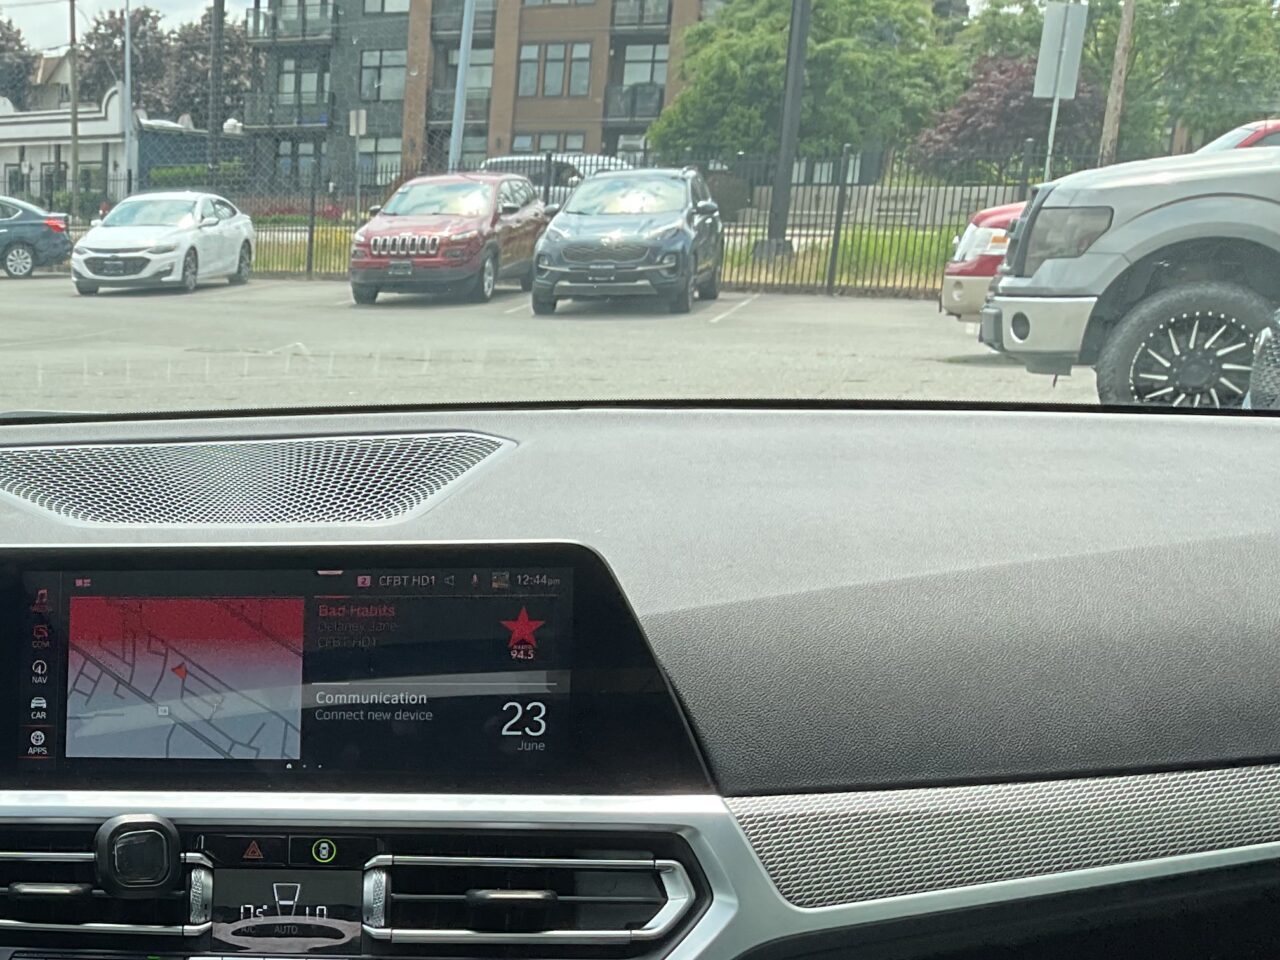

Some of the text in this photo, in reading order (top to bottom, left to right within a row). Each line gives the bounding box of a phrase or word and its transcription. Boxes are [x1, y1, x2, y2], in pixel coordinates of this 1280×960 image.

[379, 576, 409, 586] CFBT
[412, 576, 436, 586] HD1
[351, 605, 395, 616] Habits
[510, 650, 535, 660] 94.5
[32, 676, 48, 684] NAV
[315, 691, 428, 705] Communication
[31, 711, 47, 719] CAR
[315, 709, 434, 721] Connect new device
[501, 701, 547, 737] 23
[28, 746, 48, 755] APPS
[517, 740, 546, 752] June
[274, 925, 298, 935] AUTO
